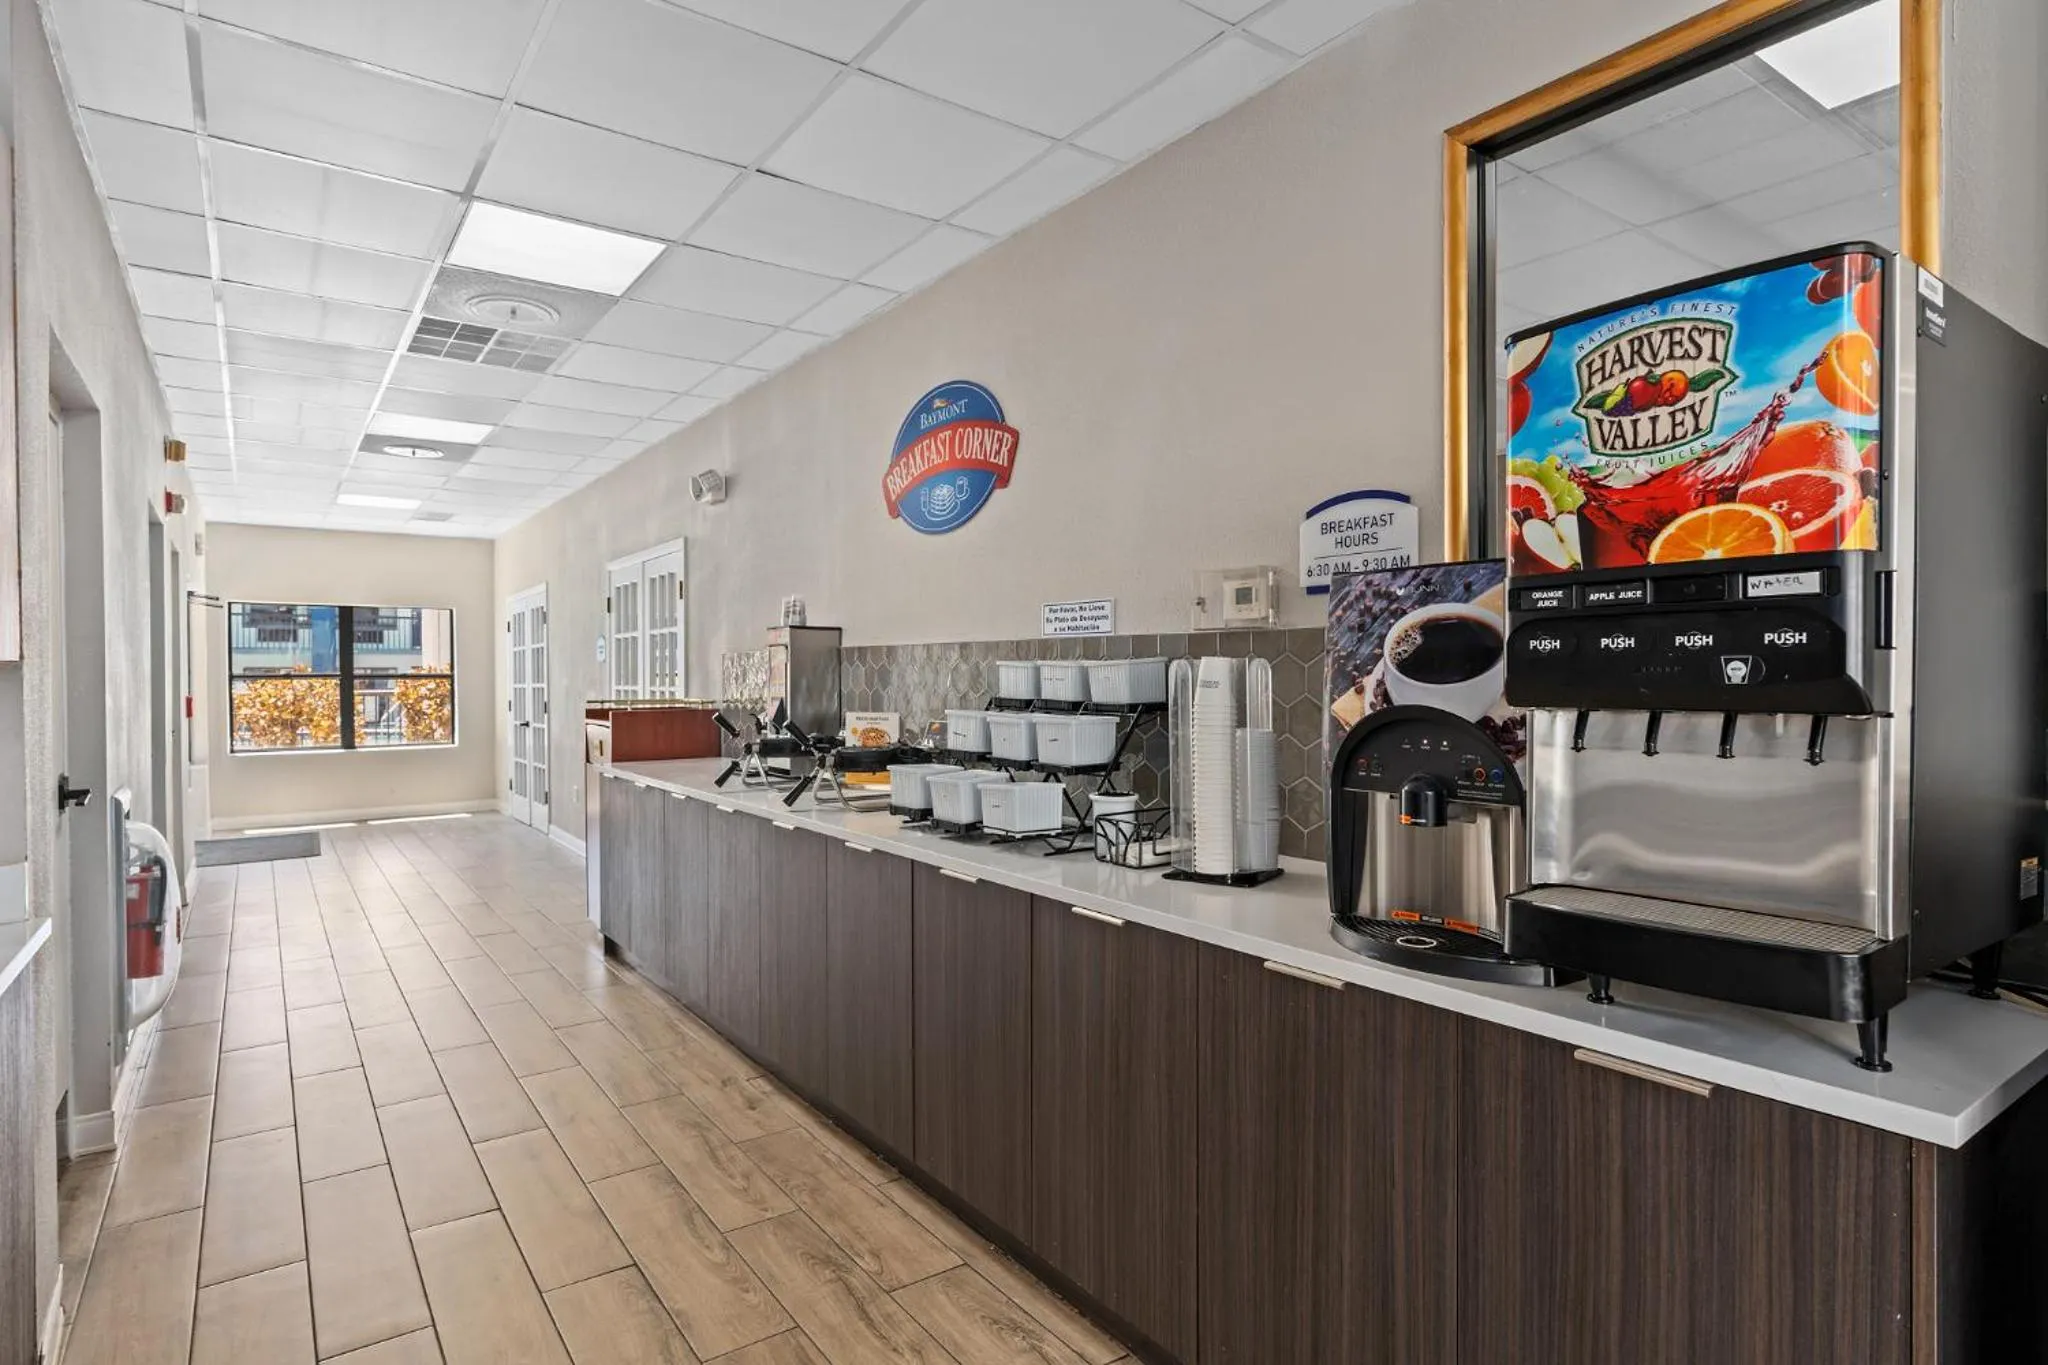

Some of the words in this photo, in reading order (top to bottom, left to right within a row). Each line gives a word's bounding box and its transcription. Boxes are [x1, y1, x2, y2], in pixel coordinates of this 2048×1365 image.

[1577, 307, 1658, 353] NATURE'S
[1670, 302, 1737, 317] FINEST
[1585, 325, 1726, 394] HARVEST
[920, 399, 968, 430] BAYMONT
[1594, 395, 1710, 451] VALLEY
[1596, 457, 1640, 470] FRUIT
[1649, 441, 1709, 466] JUICES
[886, 429, 952, 502] BREAKFAST
[954, 427, 1014, 467] CORNER
[1321, 512, 1395, 535] BREAKFAST
[1334, 532, 1379, 549] HOURS
[1306, 563, 1330, 578] 6:30
[1333, 561, 1352, 573] AM
[1362, 558, 1388, 571] 9:30
[1391, 555, 1411, 568] AM
[1531, 590, 1564, 599] ORANGE
[1589, 592, 1615, 601] APPLE
[1619, 590, 1643, 599] JUICE
[1536, 599, 1559, 608] JUICE
[1079, 614, 1109, 623] Desayuno
[1529, 638, 1560, 650] PUSH
[1600, 636, 1635, 649] PUSH
[1675, 634, 1714, 647] PUSH
[1763, 631, 1808, 645] PUSH
